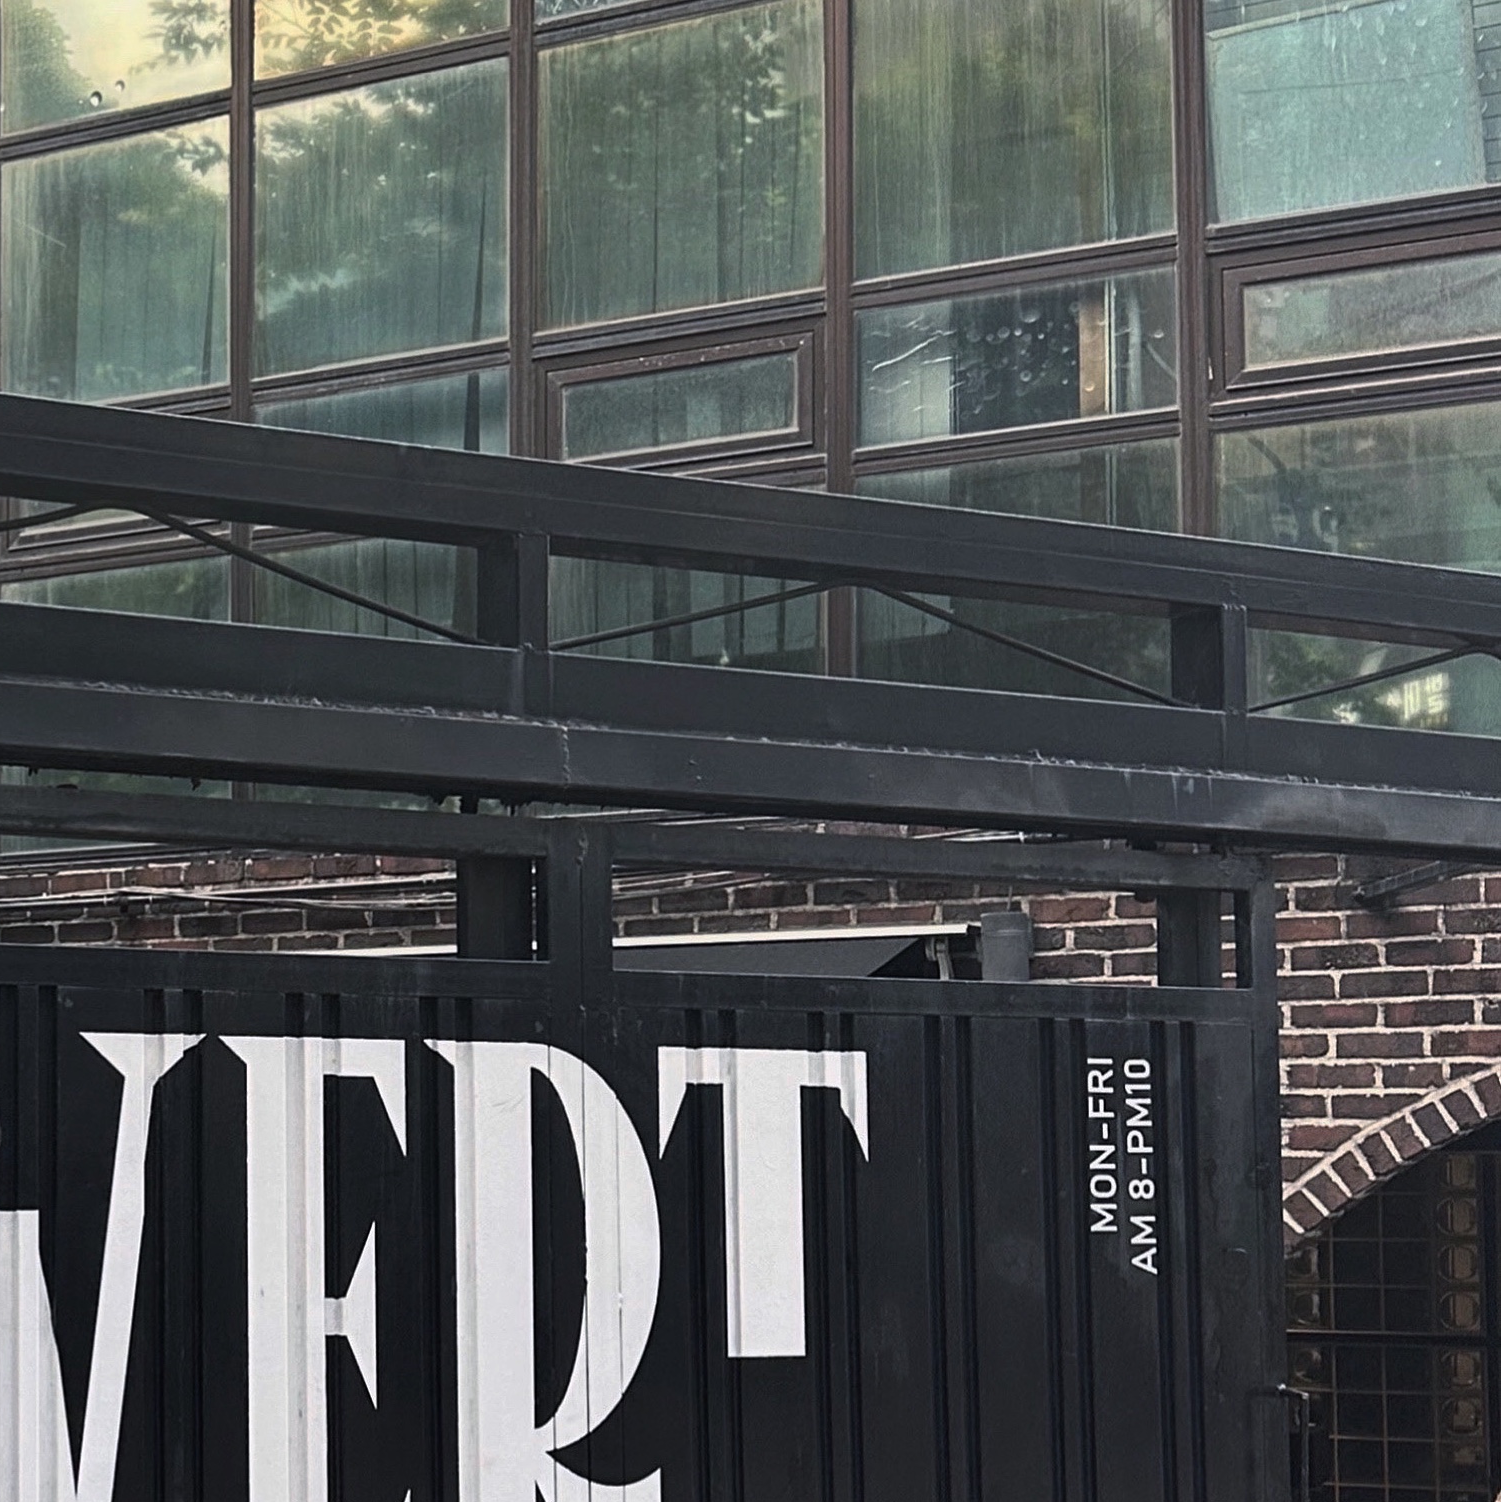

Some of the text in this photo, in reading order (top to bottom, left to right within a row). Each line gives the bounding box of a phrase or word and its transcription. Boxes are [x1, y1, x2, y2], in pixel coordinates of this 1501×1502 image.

[1086, 1057, 1118, 1232] MON-FRI
[1123, 1058, 1159, 1275] AM 8-PM10
